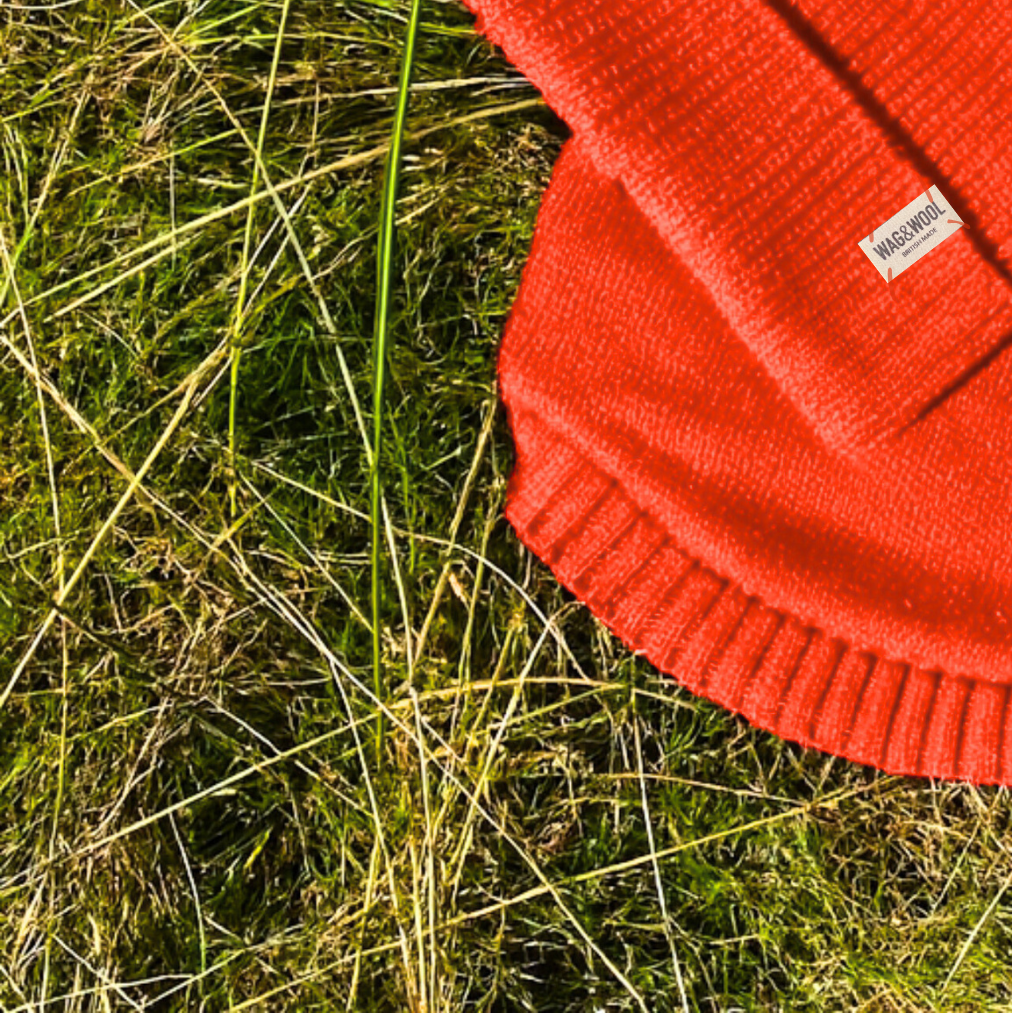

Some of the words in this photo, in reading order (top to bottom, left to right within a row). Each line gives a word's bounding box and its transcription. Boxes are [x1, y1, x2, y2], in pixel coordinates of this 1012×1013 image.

[872, 201, 946, 261] WAG&WOOL
[901, 239, 922, 258] BRITISH
[921, 227, 938, 242] MADE
